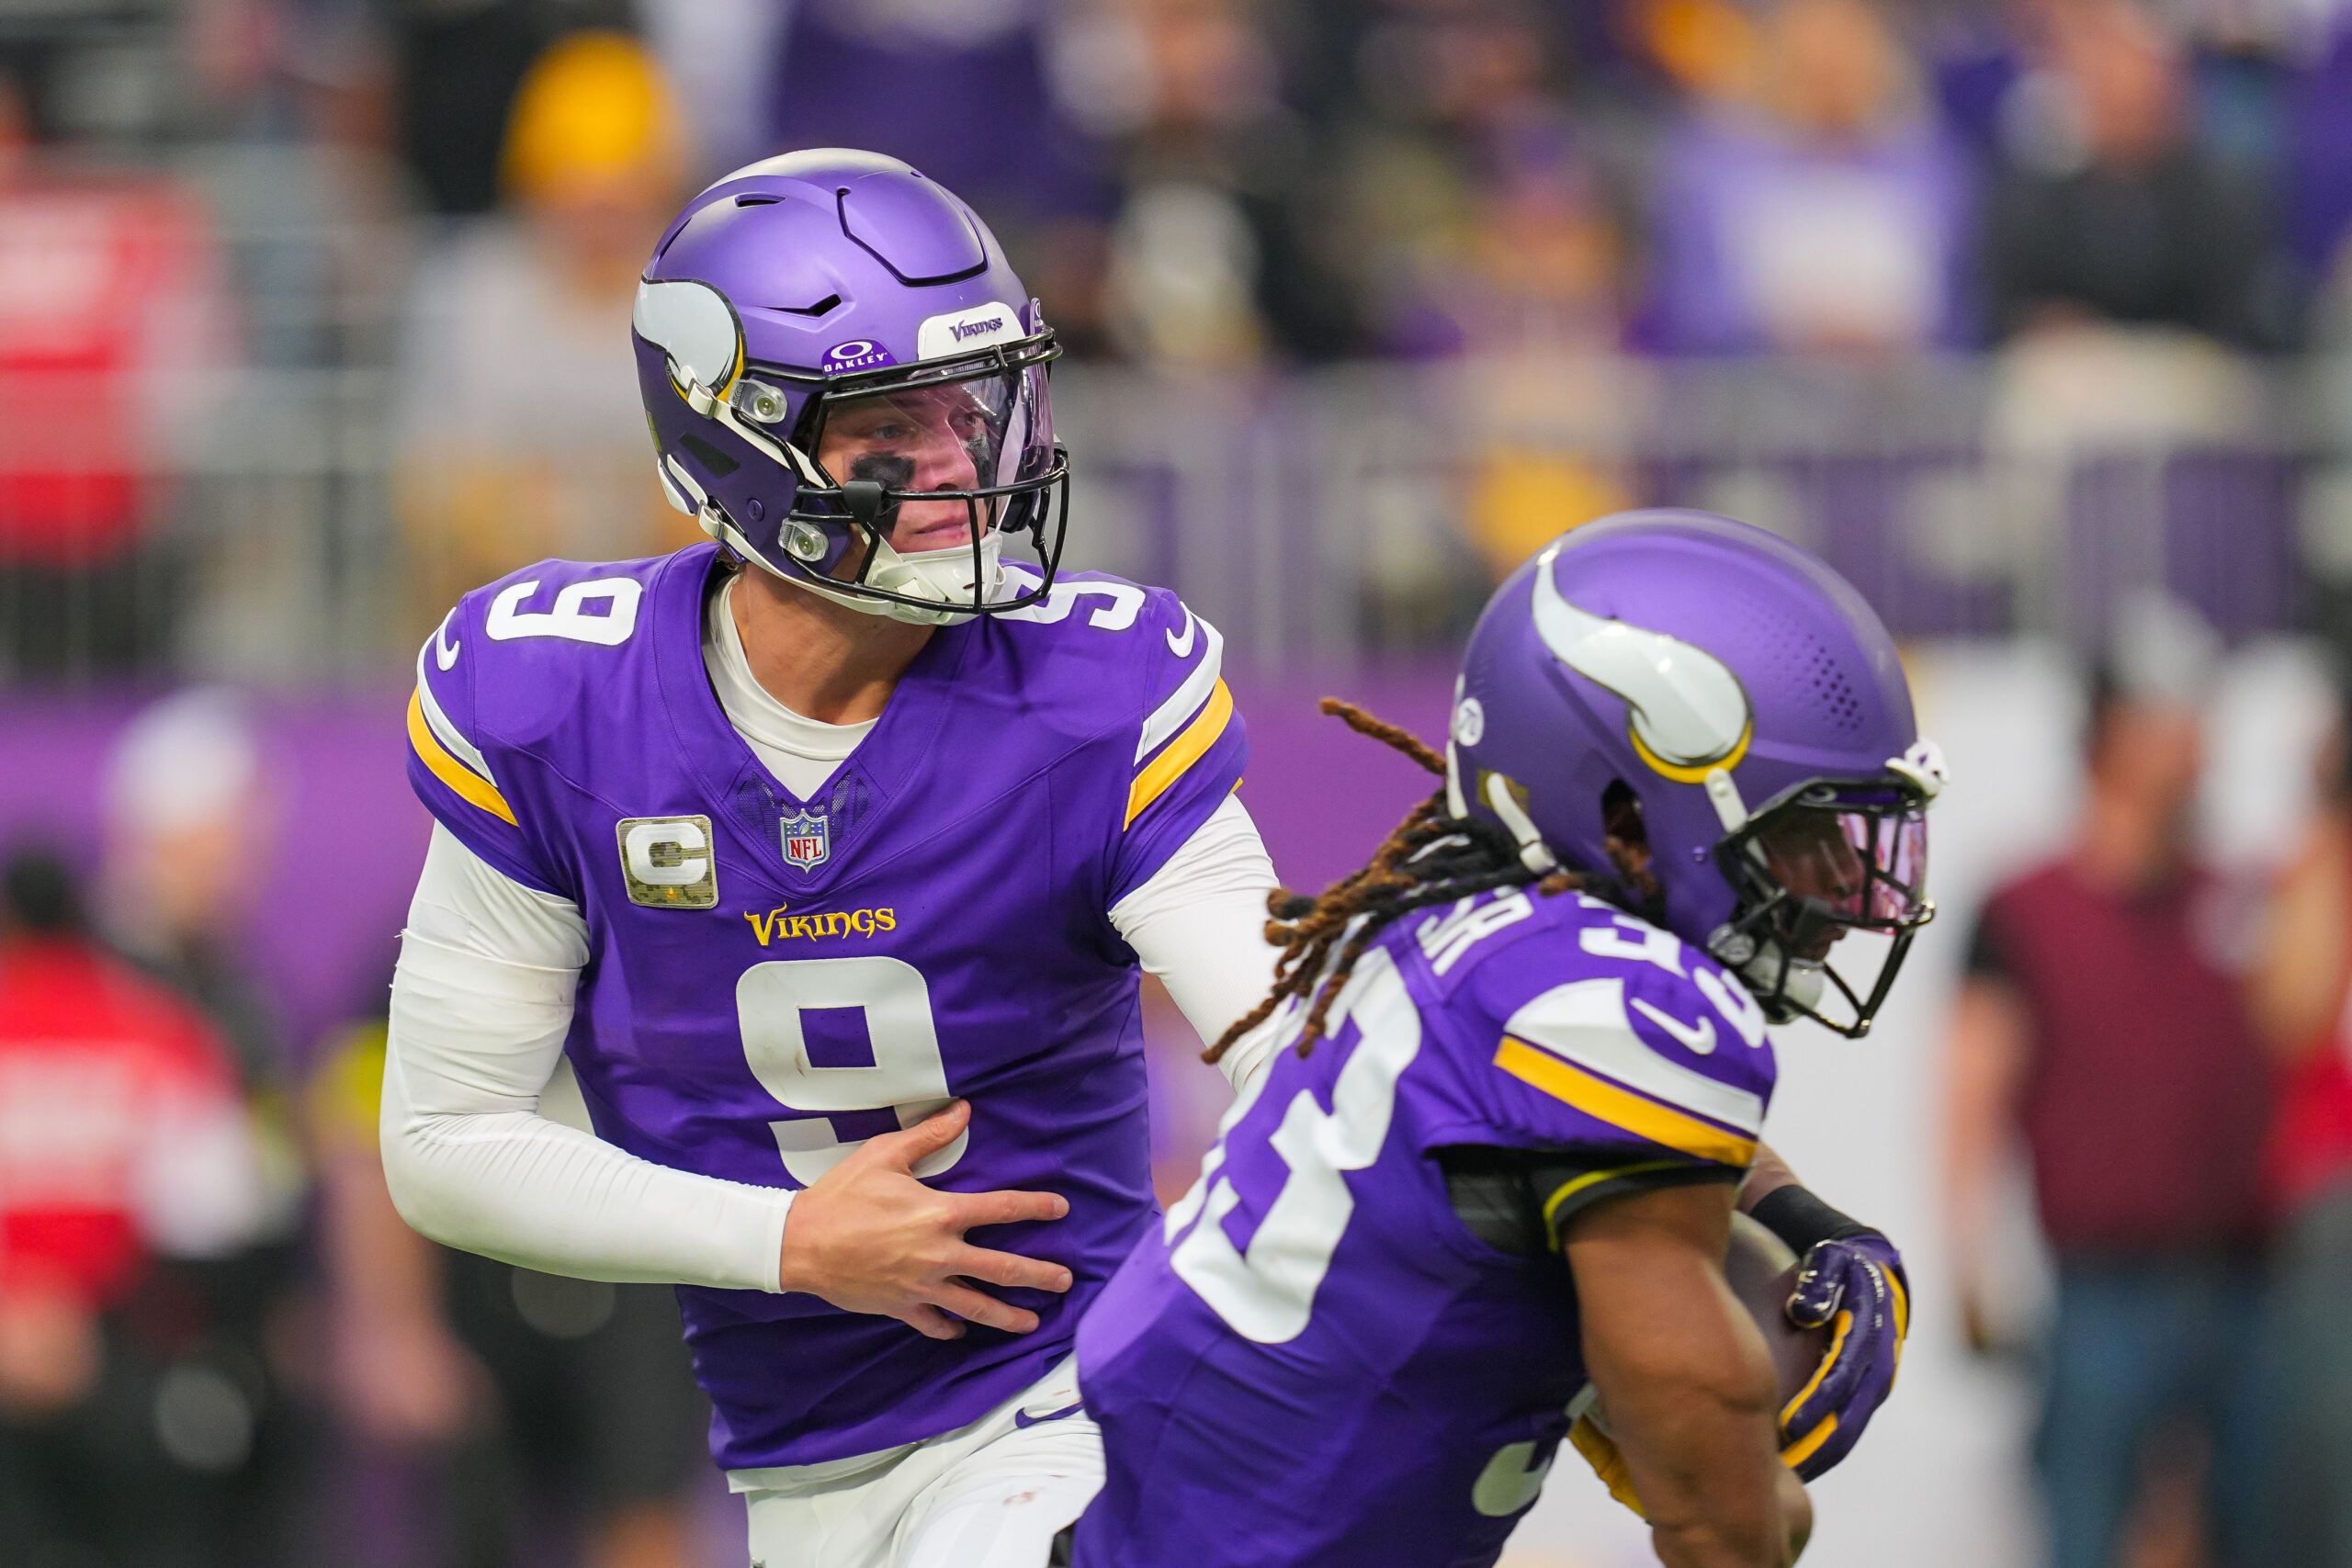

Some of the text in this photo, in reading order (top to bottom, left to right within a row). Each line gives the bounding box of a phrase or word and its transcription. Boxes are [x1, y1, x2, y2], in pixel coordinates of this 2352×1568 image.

[824, 353, 885, 372] OAKLEY
[486, 577, 642, 646] 9
[990, 566, 1146, 630] 9
[626, 823, 707, 885] C
[790, 838, 822, 860] NFL
[736, 956, 969, 1189] 9
